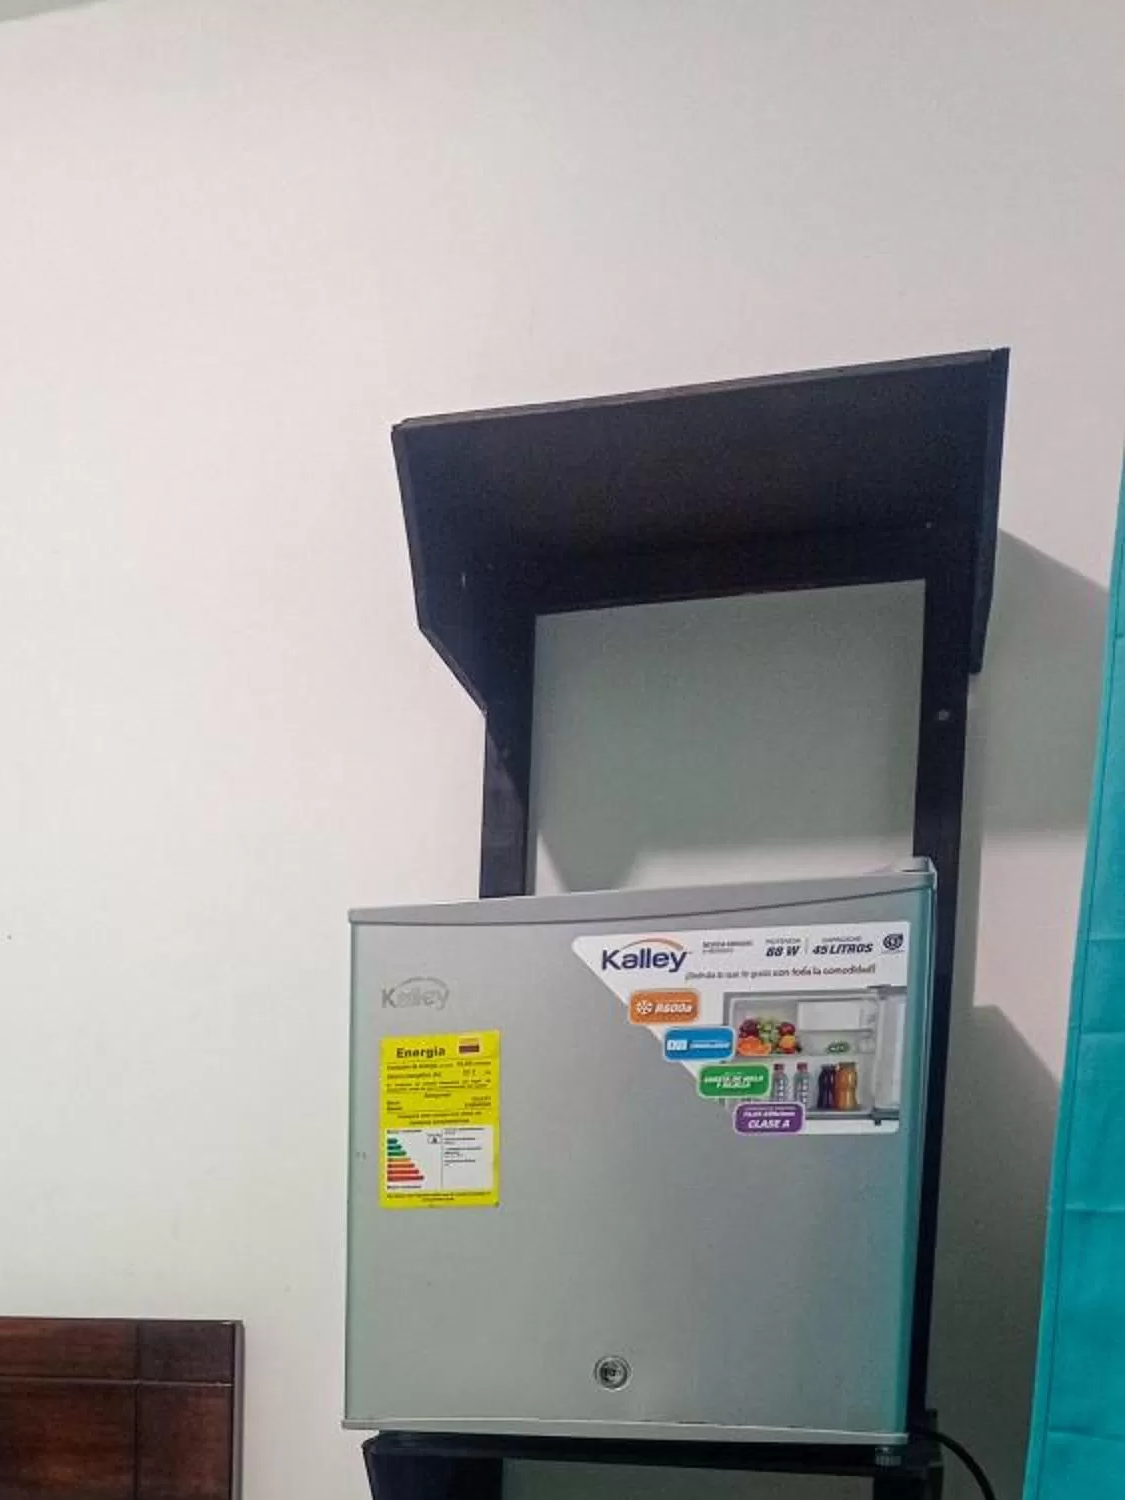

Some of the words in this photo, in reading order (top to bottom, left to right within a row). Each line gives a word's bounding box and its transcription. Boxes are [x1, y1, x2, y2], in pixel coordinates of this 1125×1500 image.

[786, 945, 800, 957] W
[829, 943, 874, 955] LITROS
[601, 947, 688, 973] Kalley
[747, 1118, 782, 1129] CLASE
[782, 1118, 791, 1129] A
